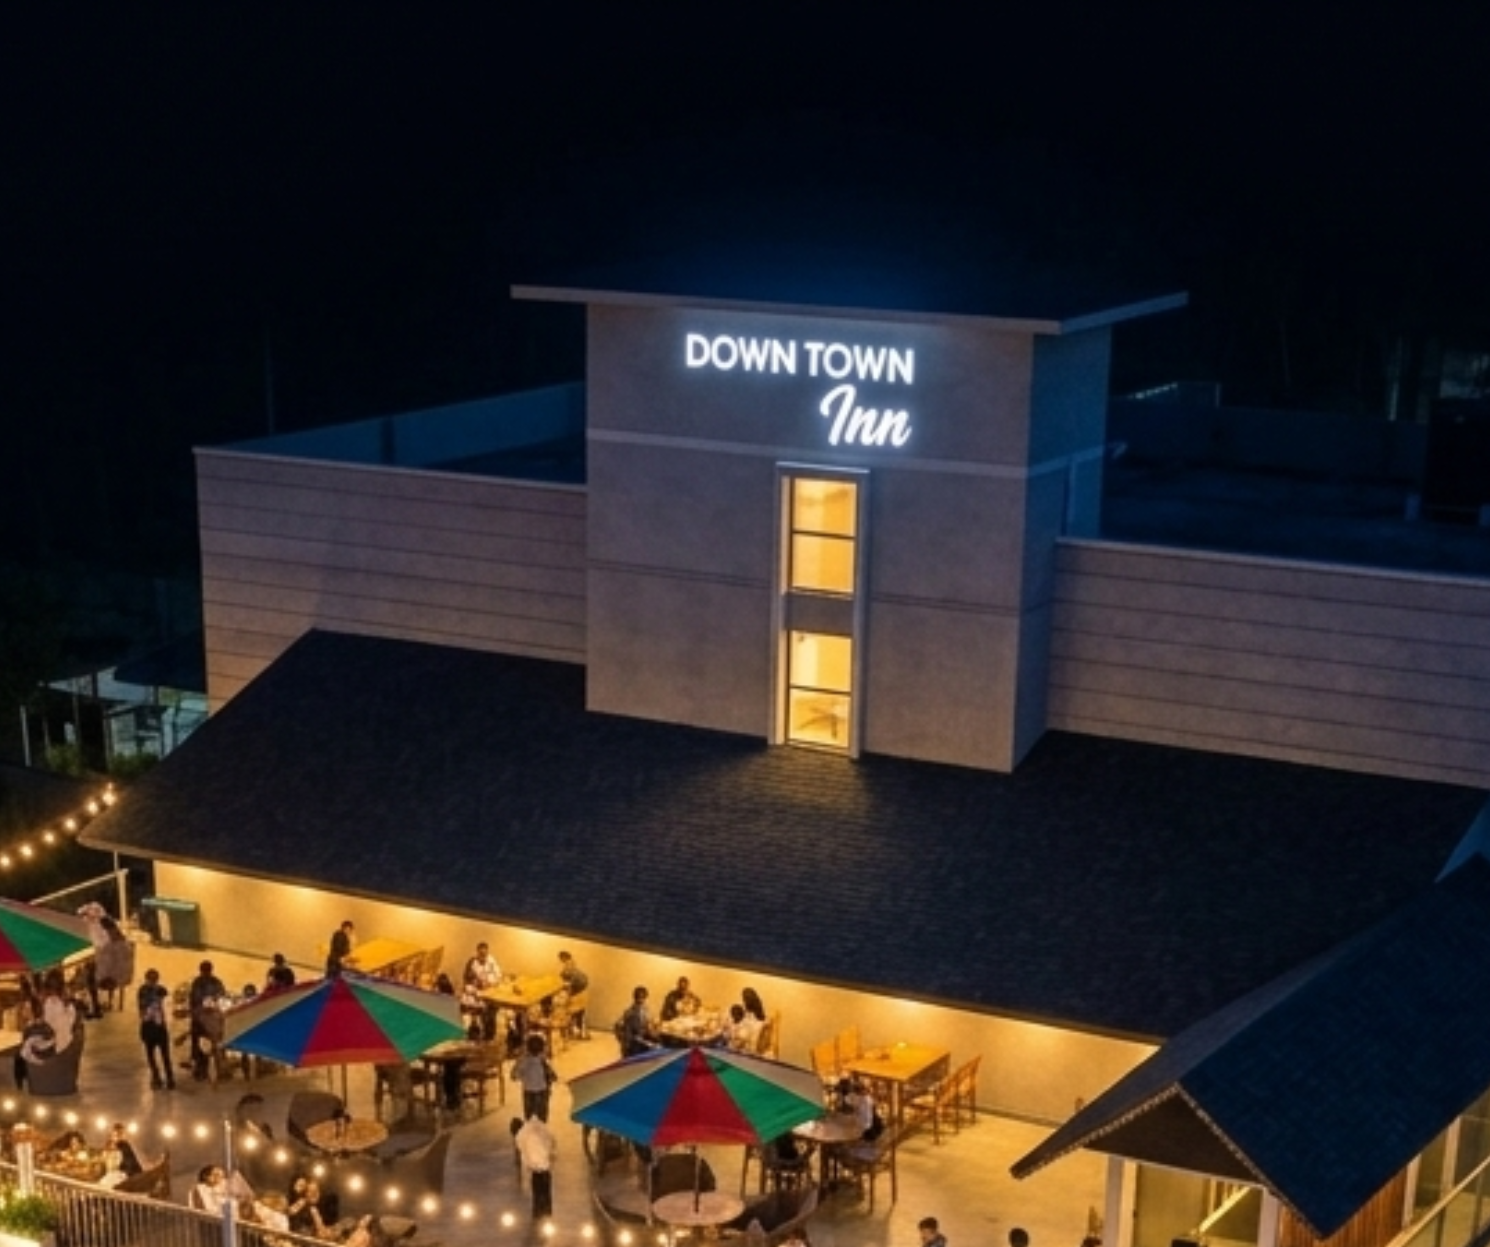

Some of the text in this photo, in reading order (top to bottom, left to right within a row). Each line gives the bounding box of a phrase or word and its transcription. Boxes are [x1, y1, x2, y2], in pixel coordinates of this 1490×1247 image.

[685, 332, 915, 385] DOWN TOWN
[819, 383, 912, 448] Inn
